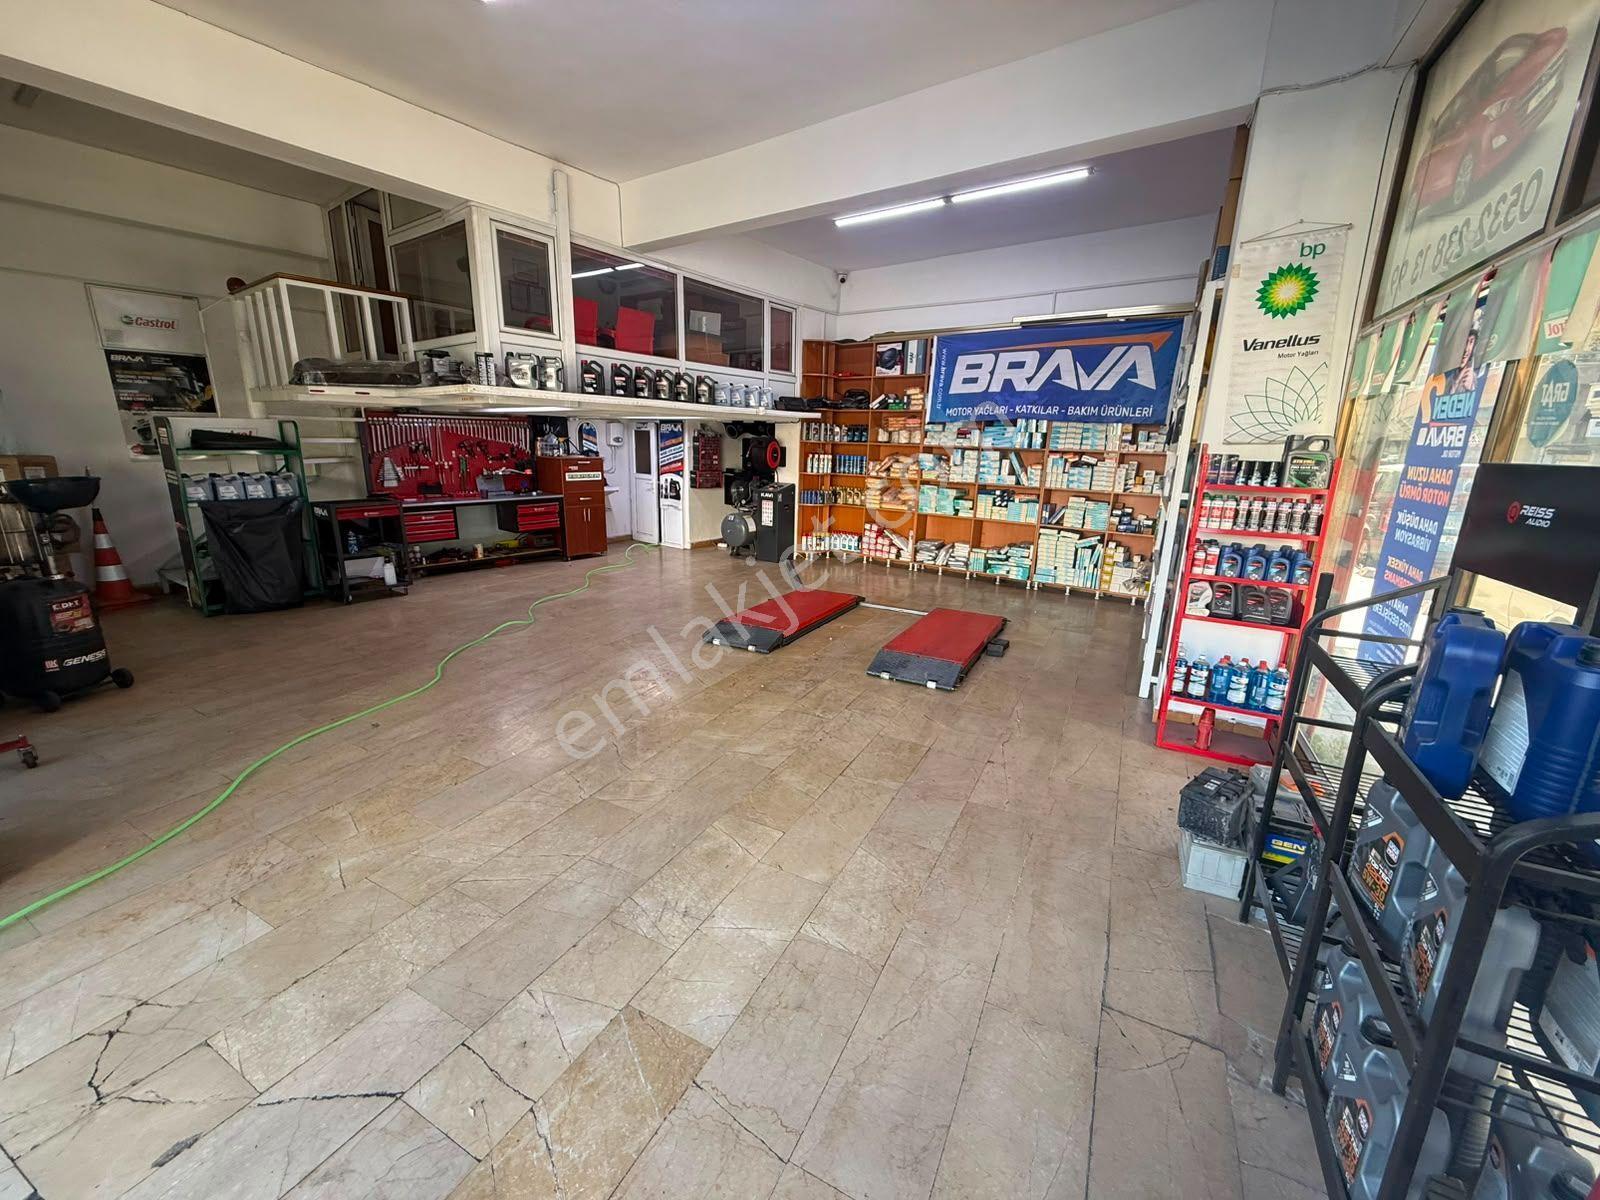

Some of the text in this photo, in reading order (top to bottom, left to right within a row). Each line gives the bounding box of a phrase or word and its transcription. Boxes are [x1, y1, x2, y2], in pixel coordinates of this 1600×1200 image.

[1299, 242, 1326, 259] bp
[134, 316, 177, 330] Castrol
[1243, 334, 1321, 352] Vanellus
[1277, 351, 1296, 359] Motor
[949, 345, 1157, 394] BRAVA
[945, 407, 973, 417] MOTOR
[974, 402, 1008, 416] YAĞLARI
[1014, 404, 1060, 415] KATKILAR
[1067, 405, 1099, 416] BAKIM
[1100, 404, 1154, 418] ÜRÜNLERİ
[1520, 505, 1556, 519] REISS
[1525, 518, 1551, 528] AUDIO
